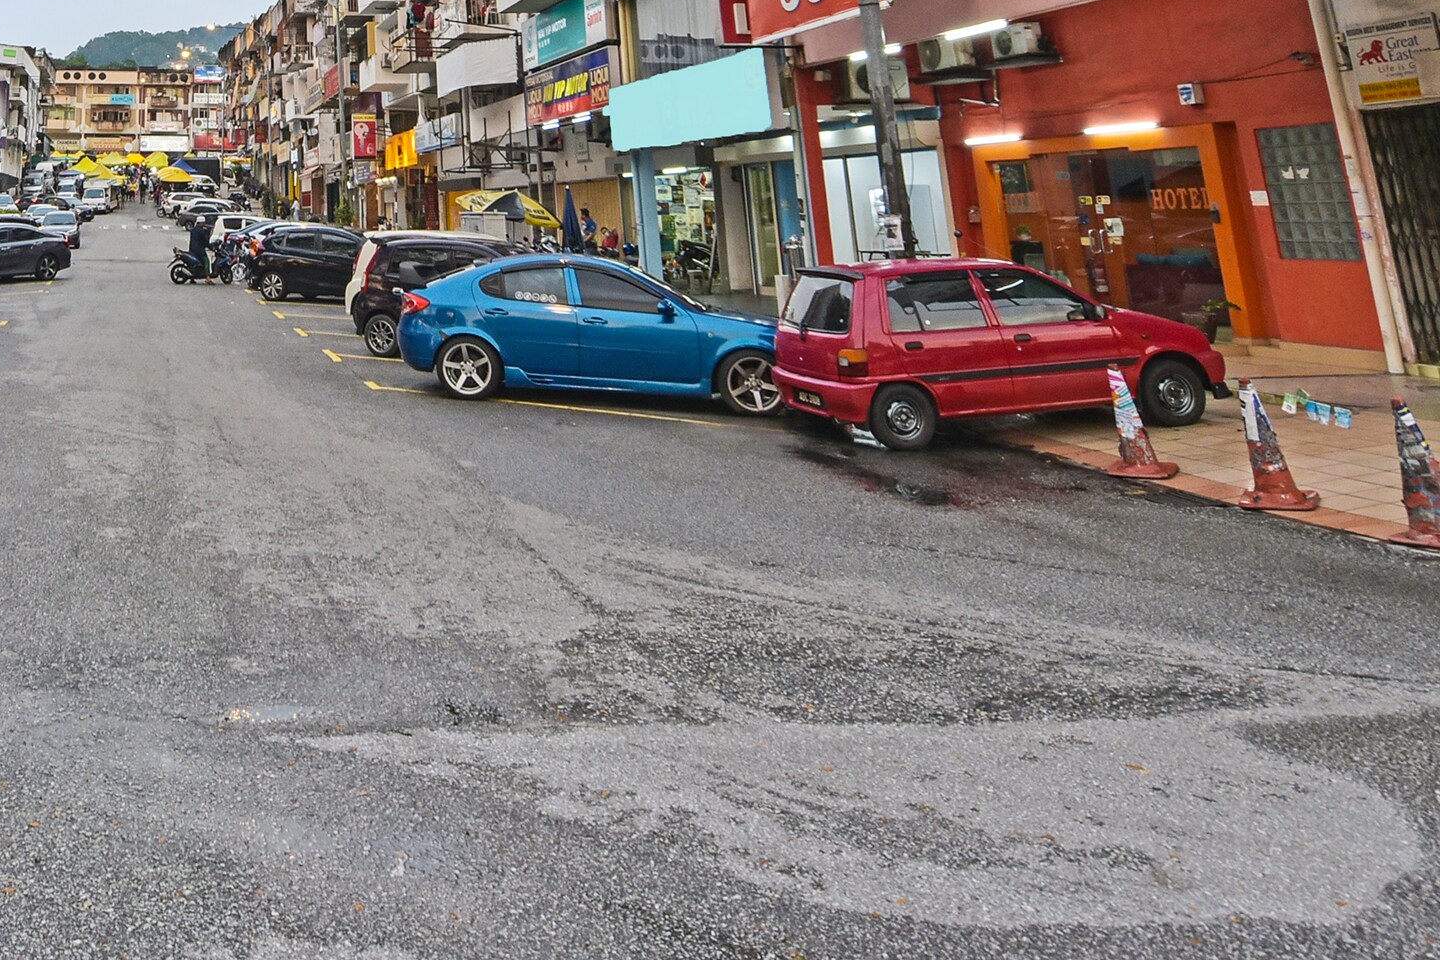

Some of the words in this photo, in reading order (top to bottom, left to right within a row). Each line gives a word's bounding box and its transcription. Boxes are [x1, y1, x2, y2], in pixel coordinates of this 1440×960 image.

[1386, 35, 1419, 49] Great
[590, 67, 609, 87] LIQUI
[591, 85, 610, 104] MOLY
[1151, 187, 1213, 210] HOTEL
